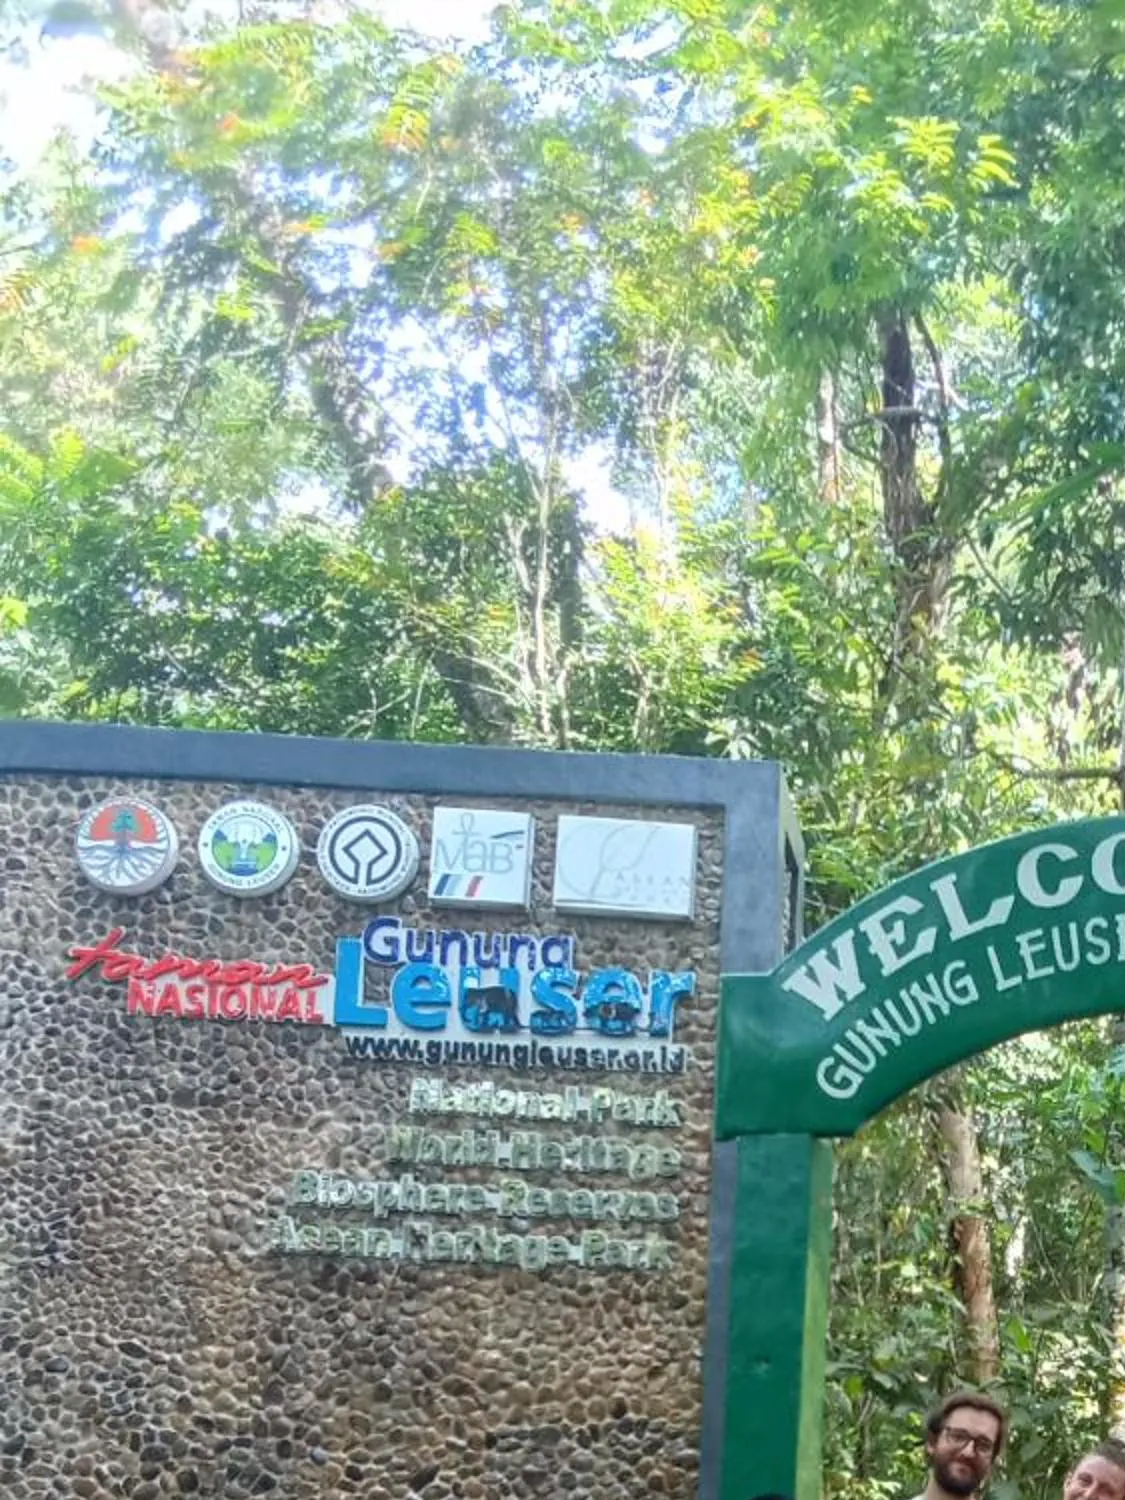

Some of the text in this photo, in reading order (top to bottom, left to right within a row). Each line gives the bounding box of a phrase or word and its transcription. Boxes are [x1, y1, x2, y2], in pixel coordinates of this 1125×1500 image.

[363, 915, 574, 970] Gunung
[127, 978, 324, 1024] NASIONAL
[334, 936, 696, 1037] Leuser
[815, 959, 979, 1100] GUNUNG
[408, 1078, 683, 1127] National Park
[387, 1126, 682, 1180] World Heritage
[291, 1170, 488, 1218] Biosphere
[273, 1215, 680, 1270] Asean Heritage Park
